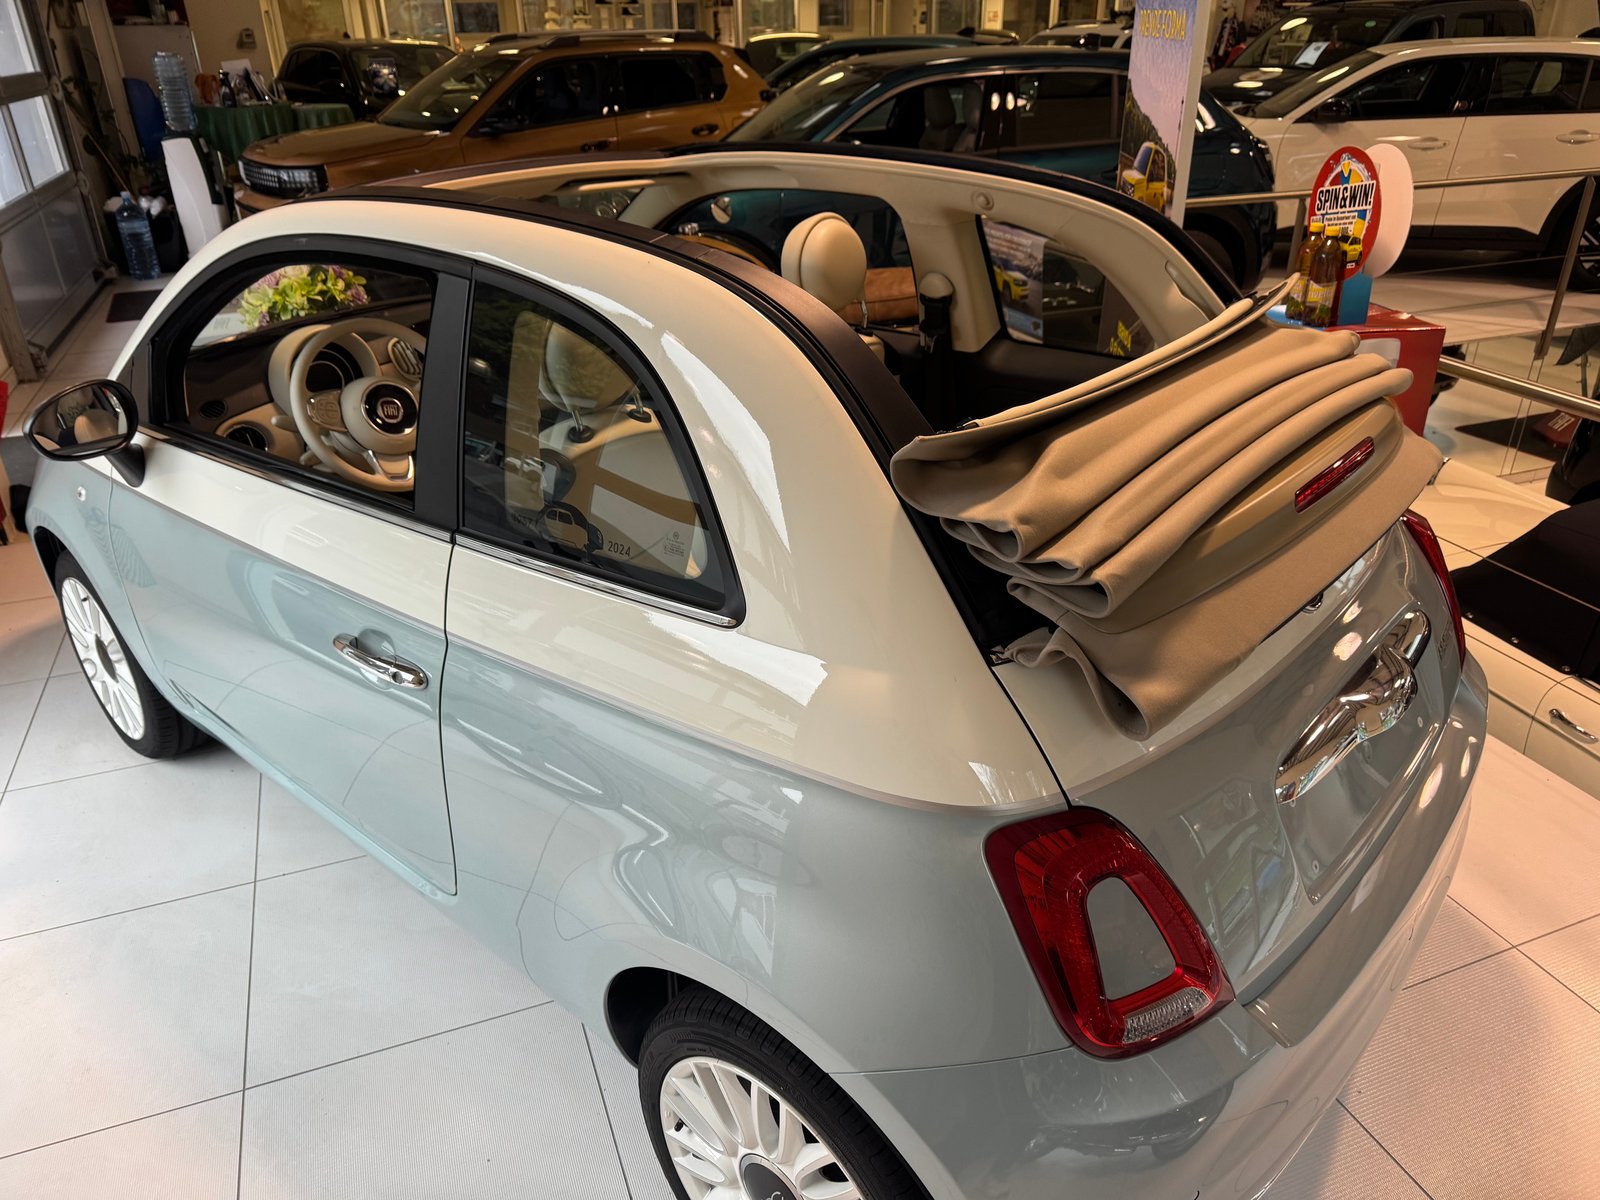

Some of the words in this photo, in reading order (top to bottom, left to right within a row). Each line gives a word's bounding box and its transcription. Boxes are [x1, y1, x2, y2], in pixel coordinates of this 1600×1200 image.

[1316, 182, 1375, 212] SPIN&WIN!
[383, 404, 399, 416] FIAT
[608, 540, 631, 557] 2024
